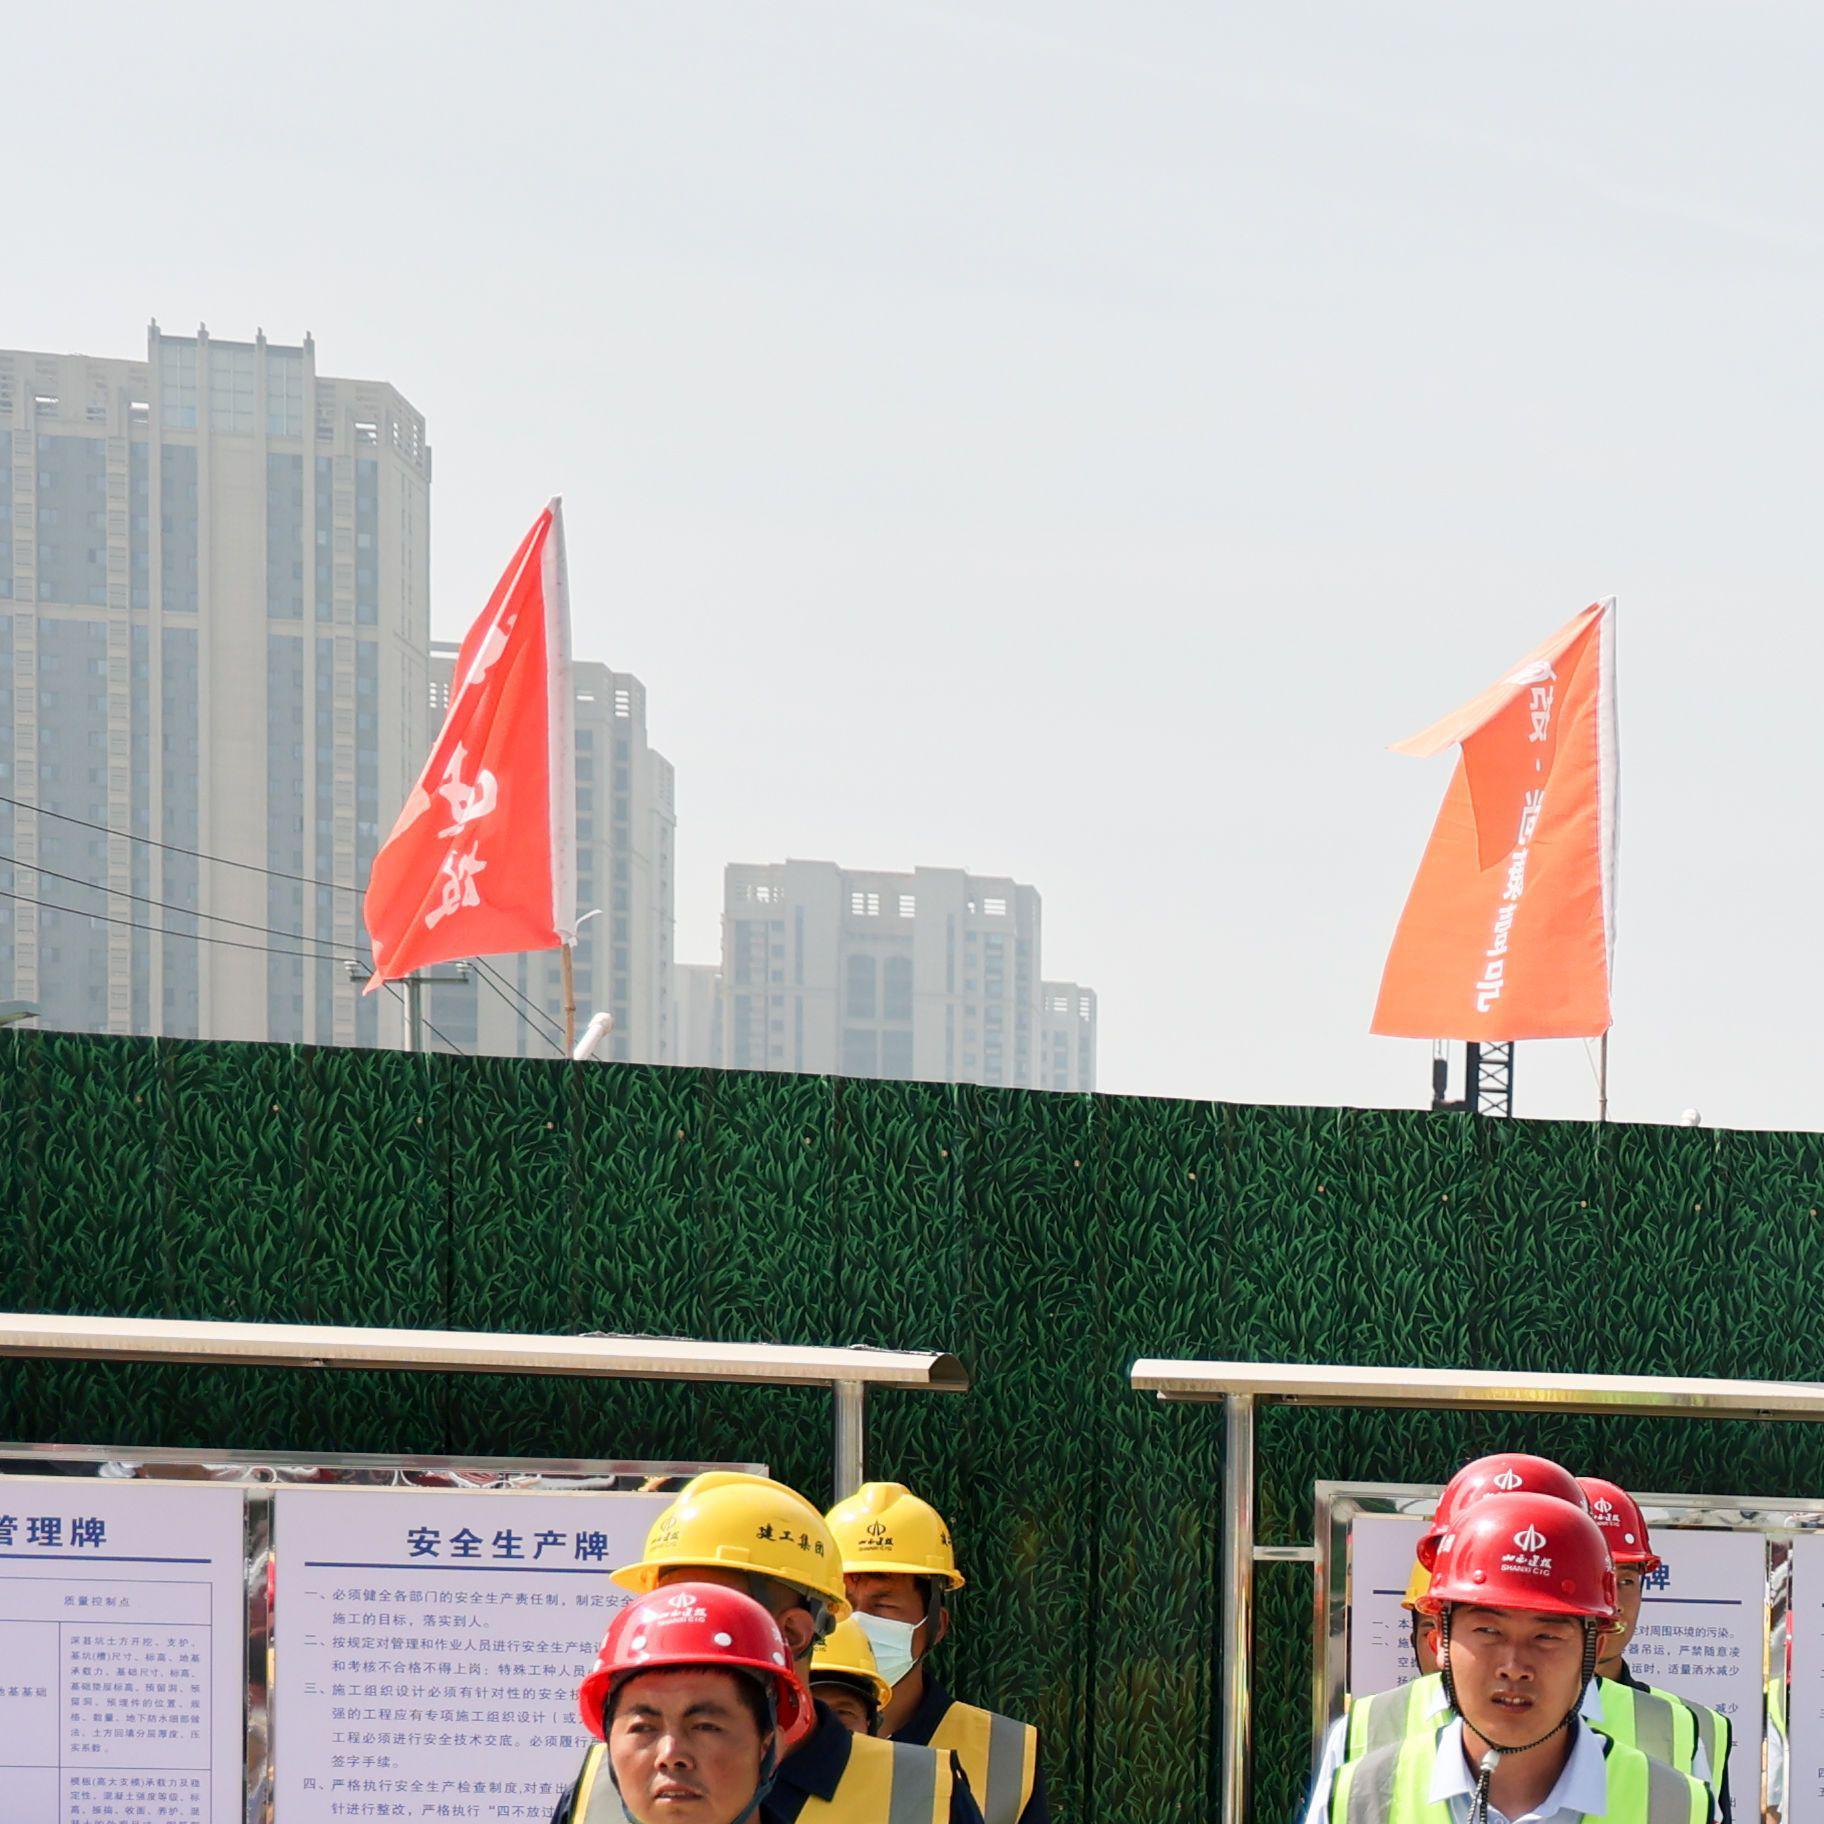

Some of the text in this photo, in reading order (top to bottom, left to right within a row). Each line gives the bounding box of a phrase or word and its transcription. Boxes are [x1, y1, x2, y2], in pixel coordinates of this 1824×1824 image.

[406, 1526, 609, 1562] 安全生产牌
[755, 1521, 826, 1558] 建工集团
[64, 1595, 130, 1608] 质量控制点
[332, 1612, 490, 1628] 施工的目标，落实到人。
[332, 1706, 584, 1725] 强的工程应有专项施工组织设计（或
[331, 1755, 400, 1770] 签字手续。
